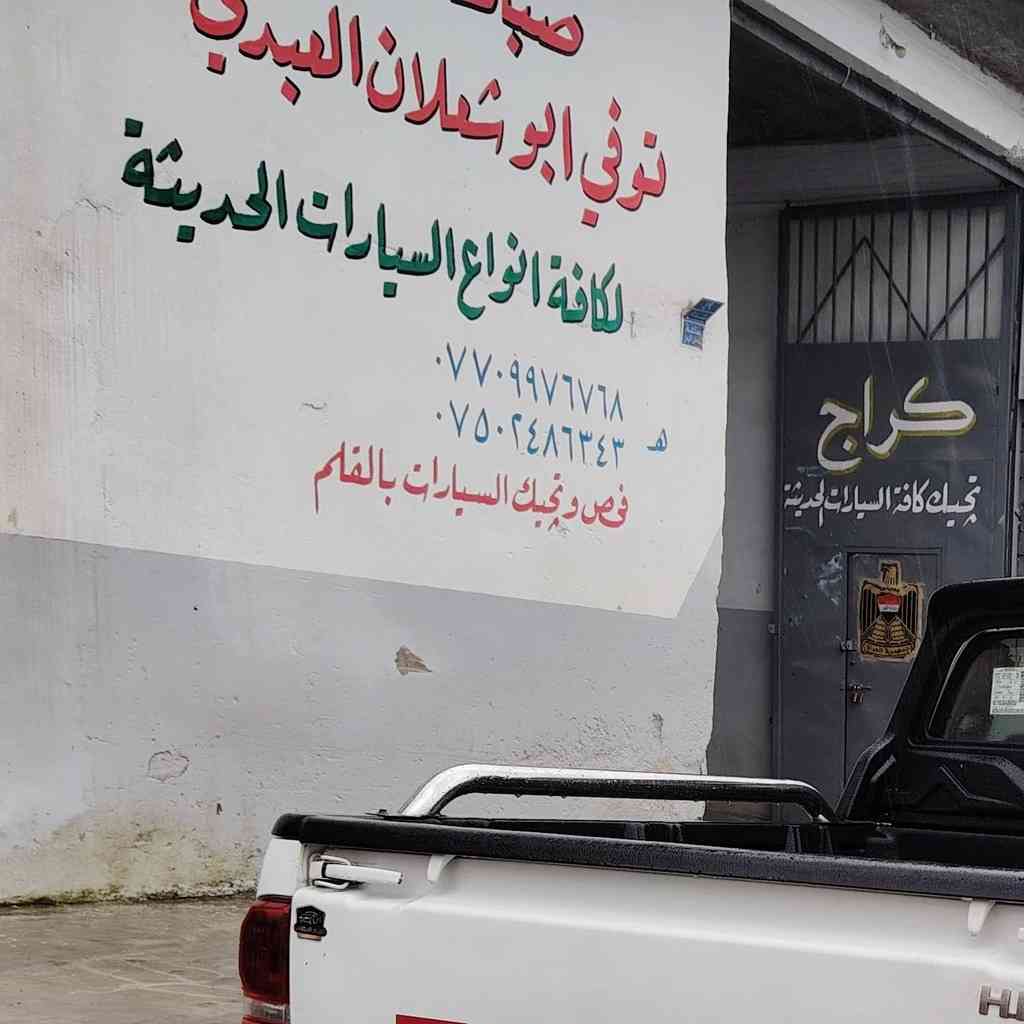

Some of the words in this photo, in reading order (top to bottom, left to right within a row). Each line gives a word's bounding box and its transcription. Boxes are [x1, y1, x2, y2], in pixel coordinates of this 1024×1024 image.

[366, 26, 504, 155] شعلان
[121, 118, 289, 243] الحديثة
[510, 102, 573, 184] ابو
[297, 182, 456, 298] السيارات
[457, 231, 540, 321] انواع
[547, 255, 624, 334] لكافة
[435, 342, 624, 421] ٠٧٧٠٩٩٧٦٧٦٨
[816, 376, 977, 475] كراج
[313, 441, 397, 515] بالقلم
[403, 456, 509, 517] السيارات
[824, 485, 891, 520] السيارات
[892, 478, 931, 516] كافة
